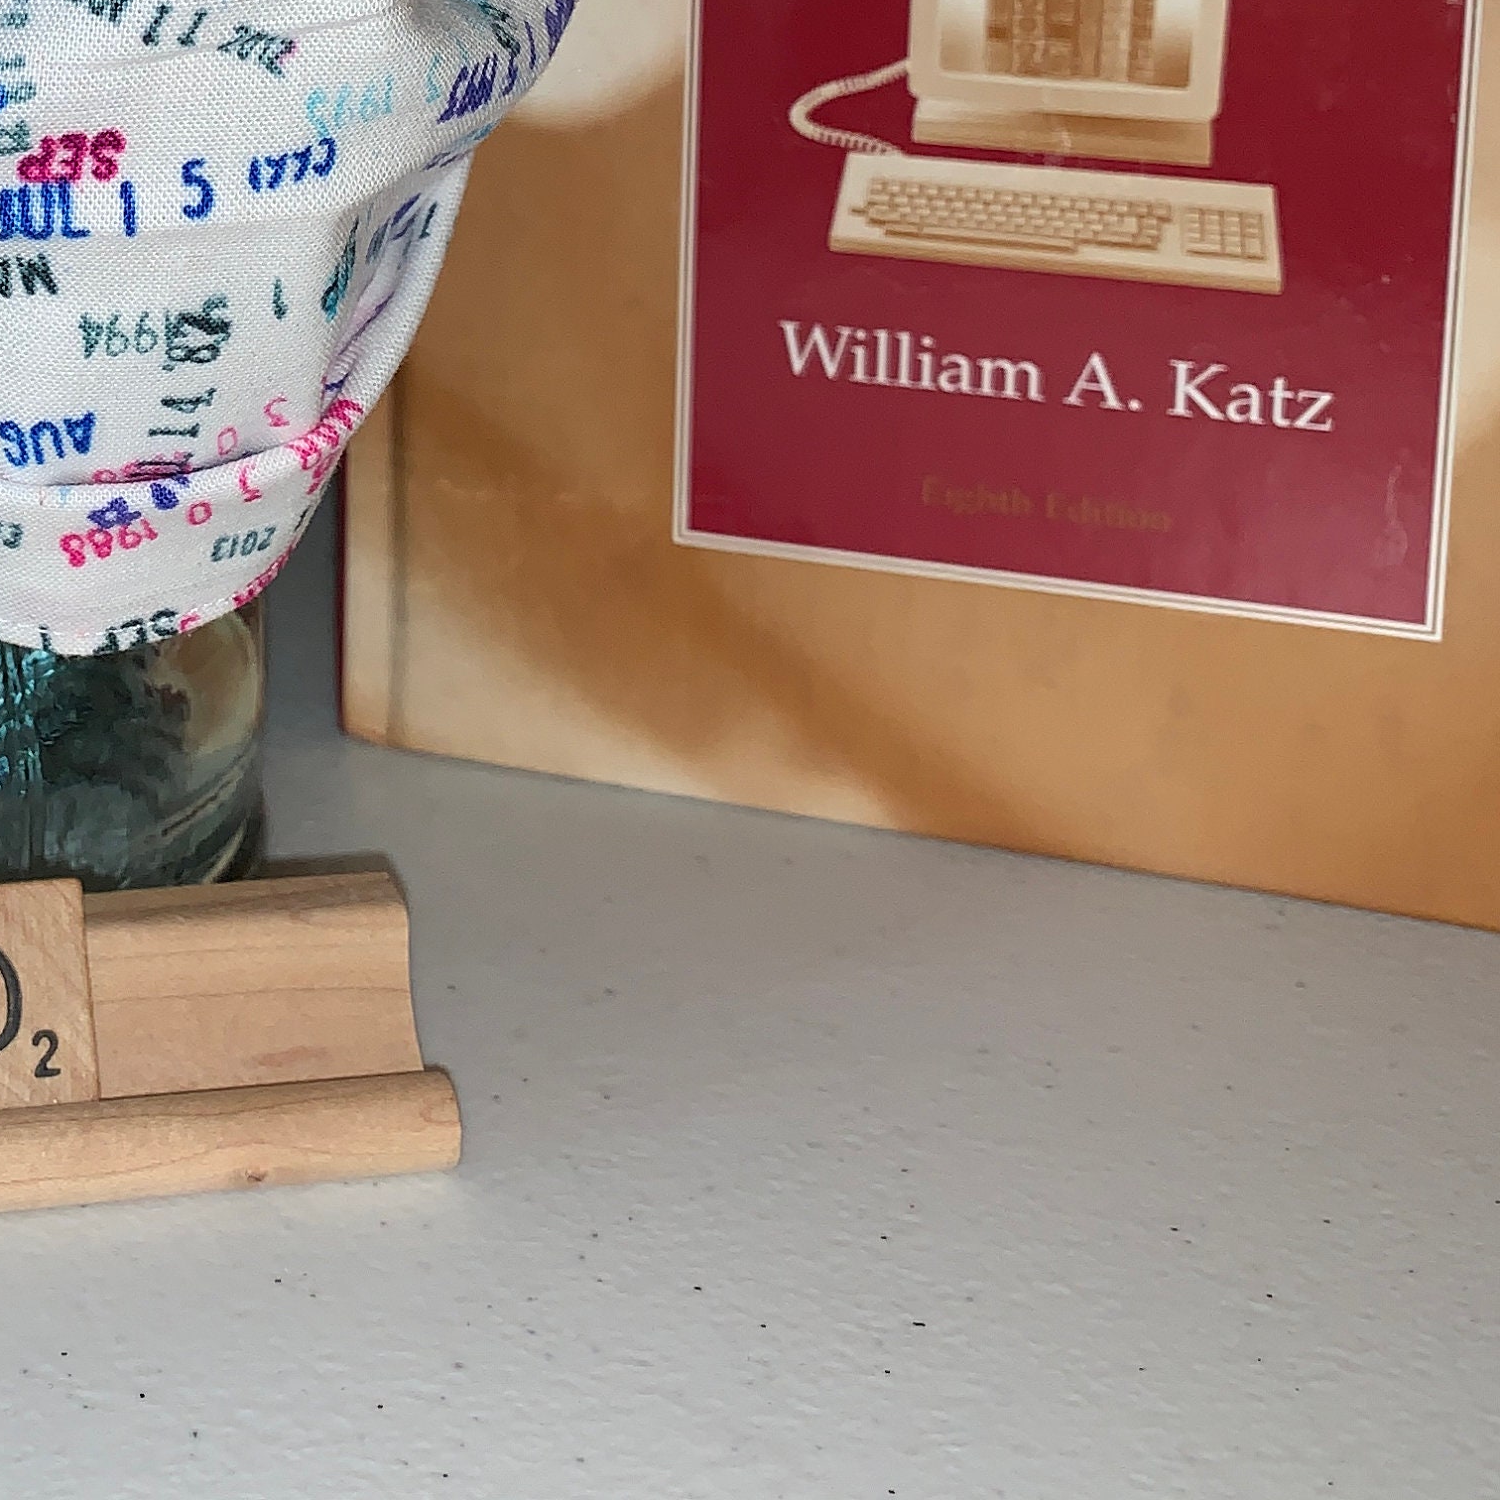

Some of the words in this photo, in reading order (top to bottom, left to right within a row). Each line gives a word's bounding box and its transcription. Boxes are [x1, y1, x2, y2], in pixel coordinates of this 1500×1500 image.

[16, 128, 127, 183] SEP
[780, 320, 1046, 404] William
[1063, 352, 1143, 414] A.
[1167, 359, 1335, 434] Katz
[4, 411, 97, 468] AUG
